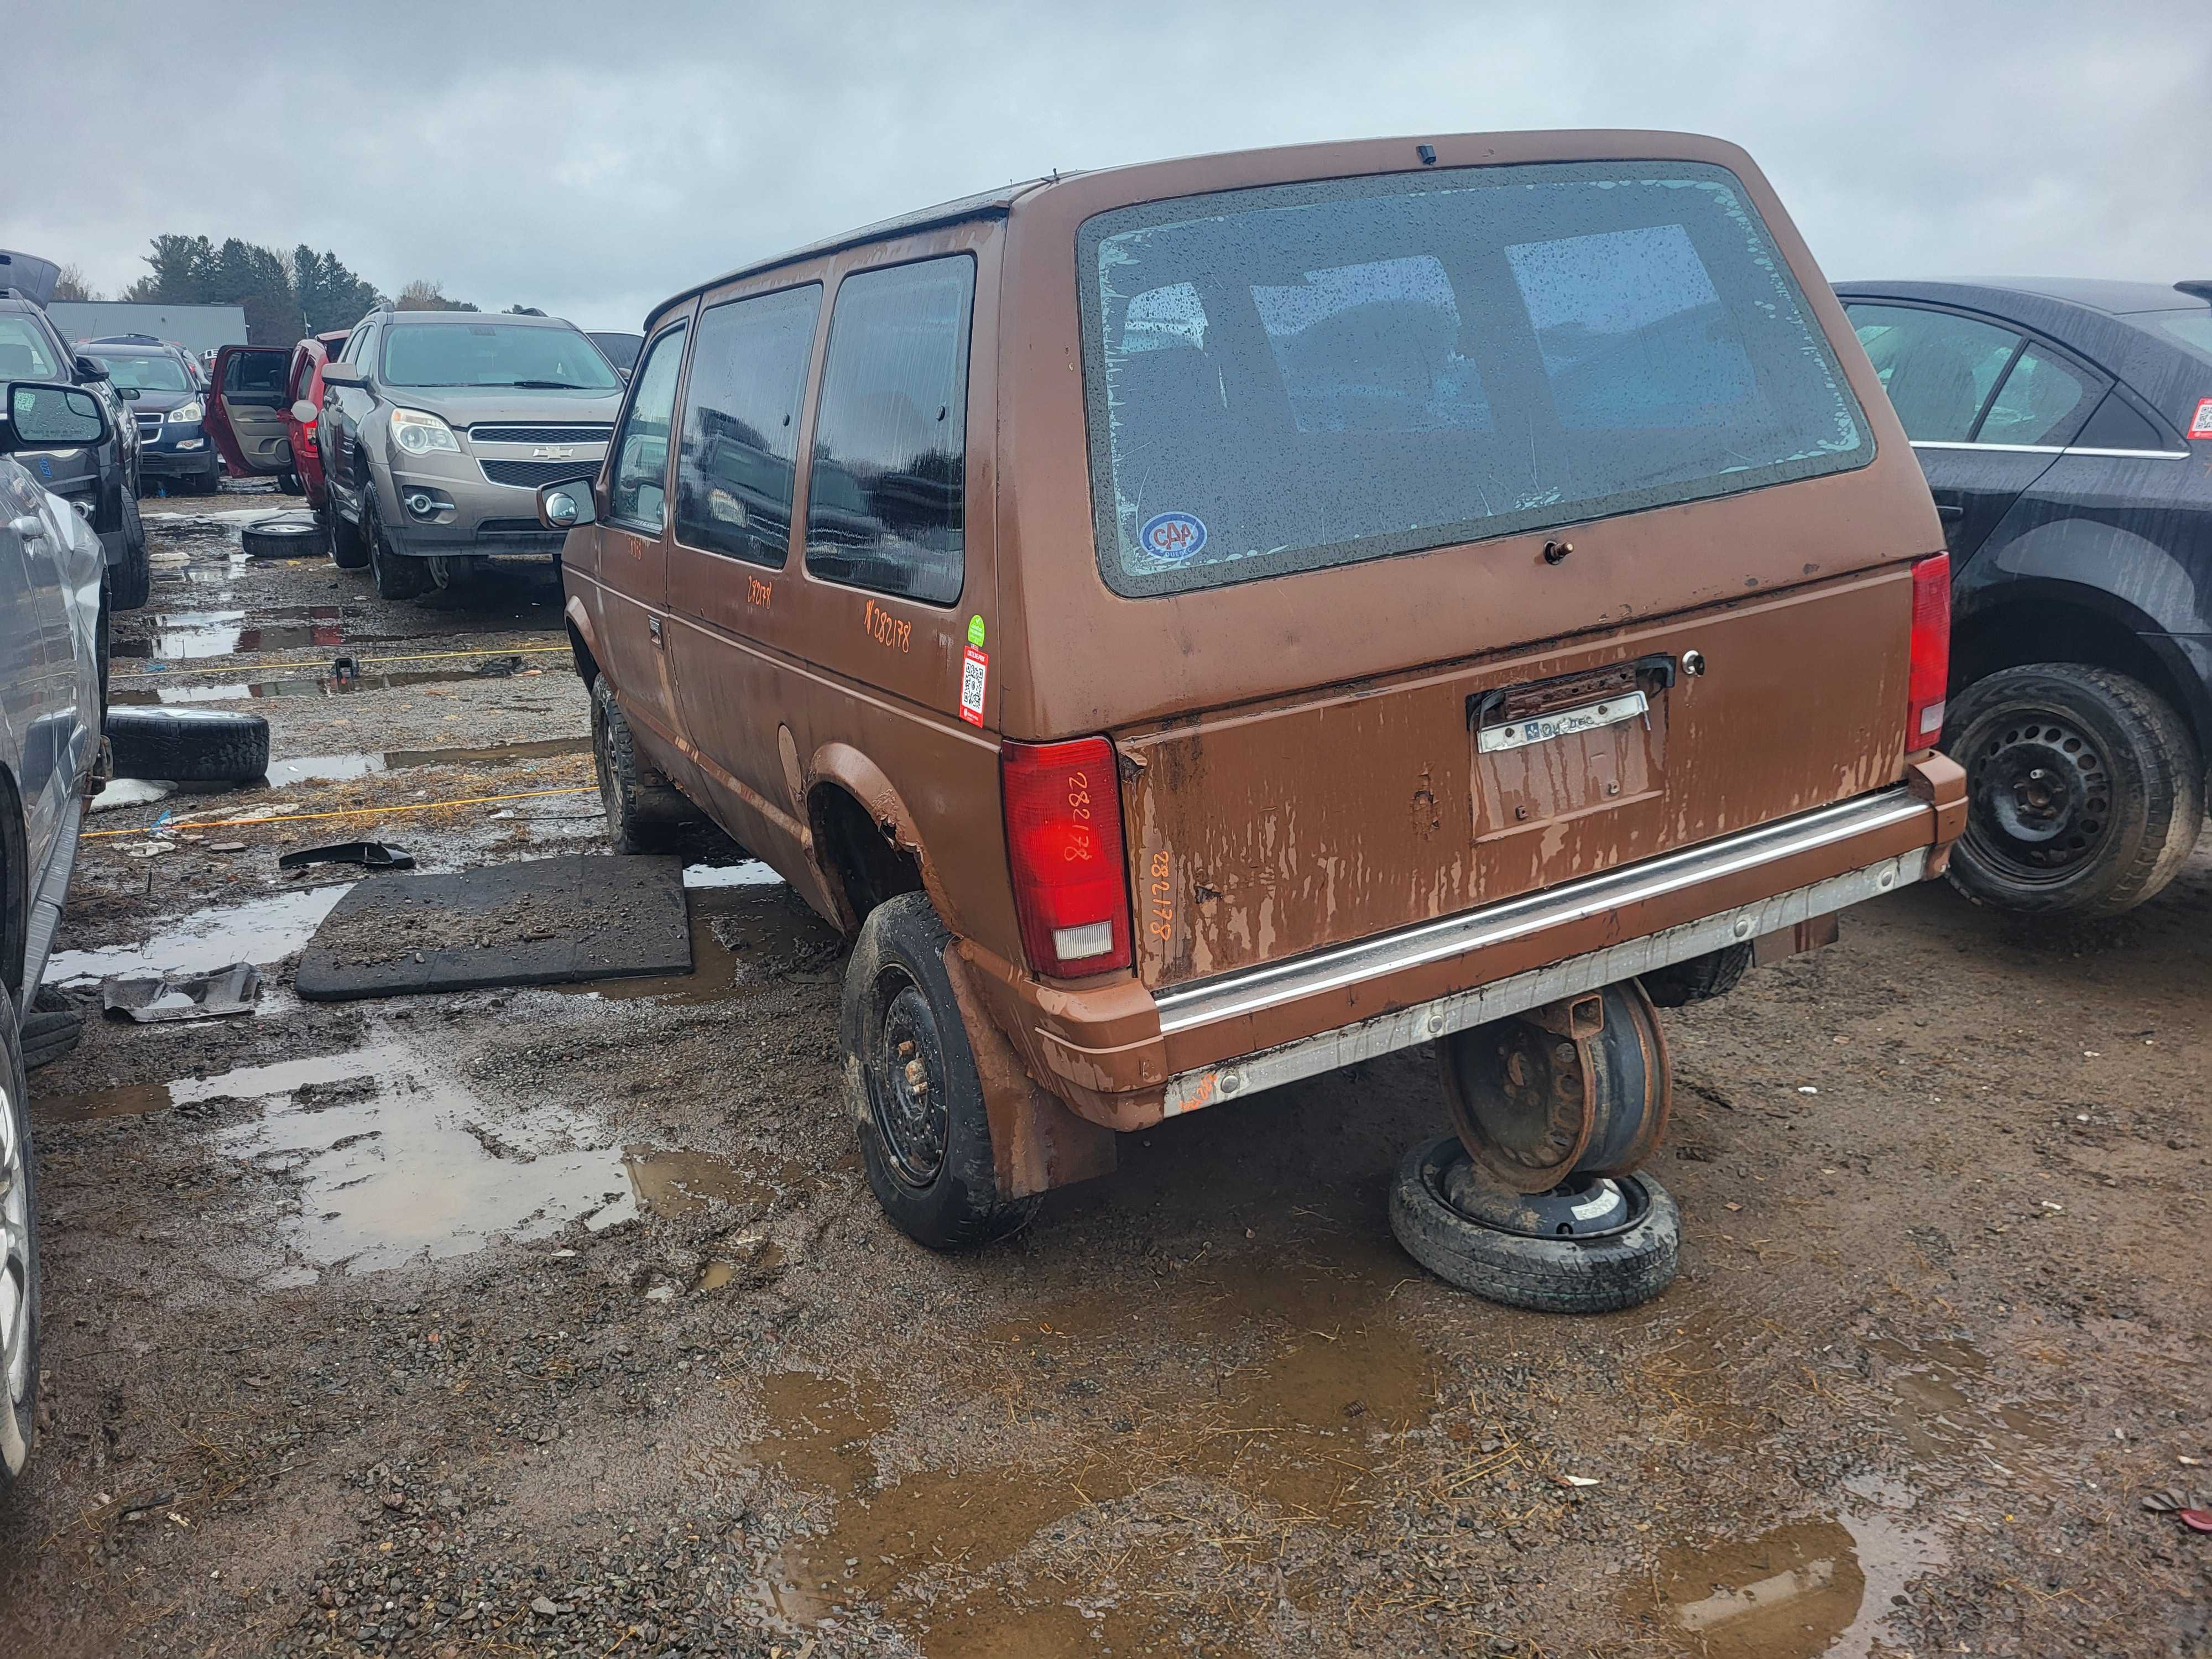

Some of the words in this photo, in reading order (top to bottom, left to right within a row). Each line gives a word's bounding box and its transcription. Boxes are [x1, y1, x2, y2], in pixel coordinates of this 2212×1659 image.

[1153, 522, 1194, 550] CAA
[874, 608, 911, 653] 282178
[1064, 771, 1092, 861] 282178
[1150, 850, 1172, 941] 282178
